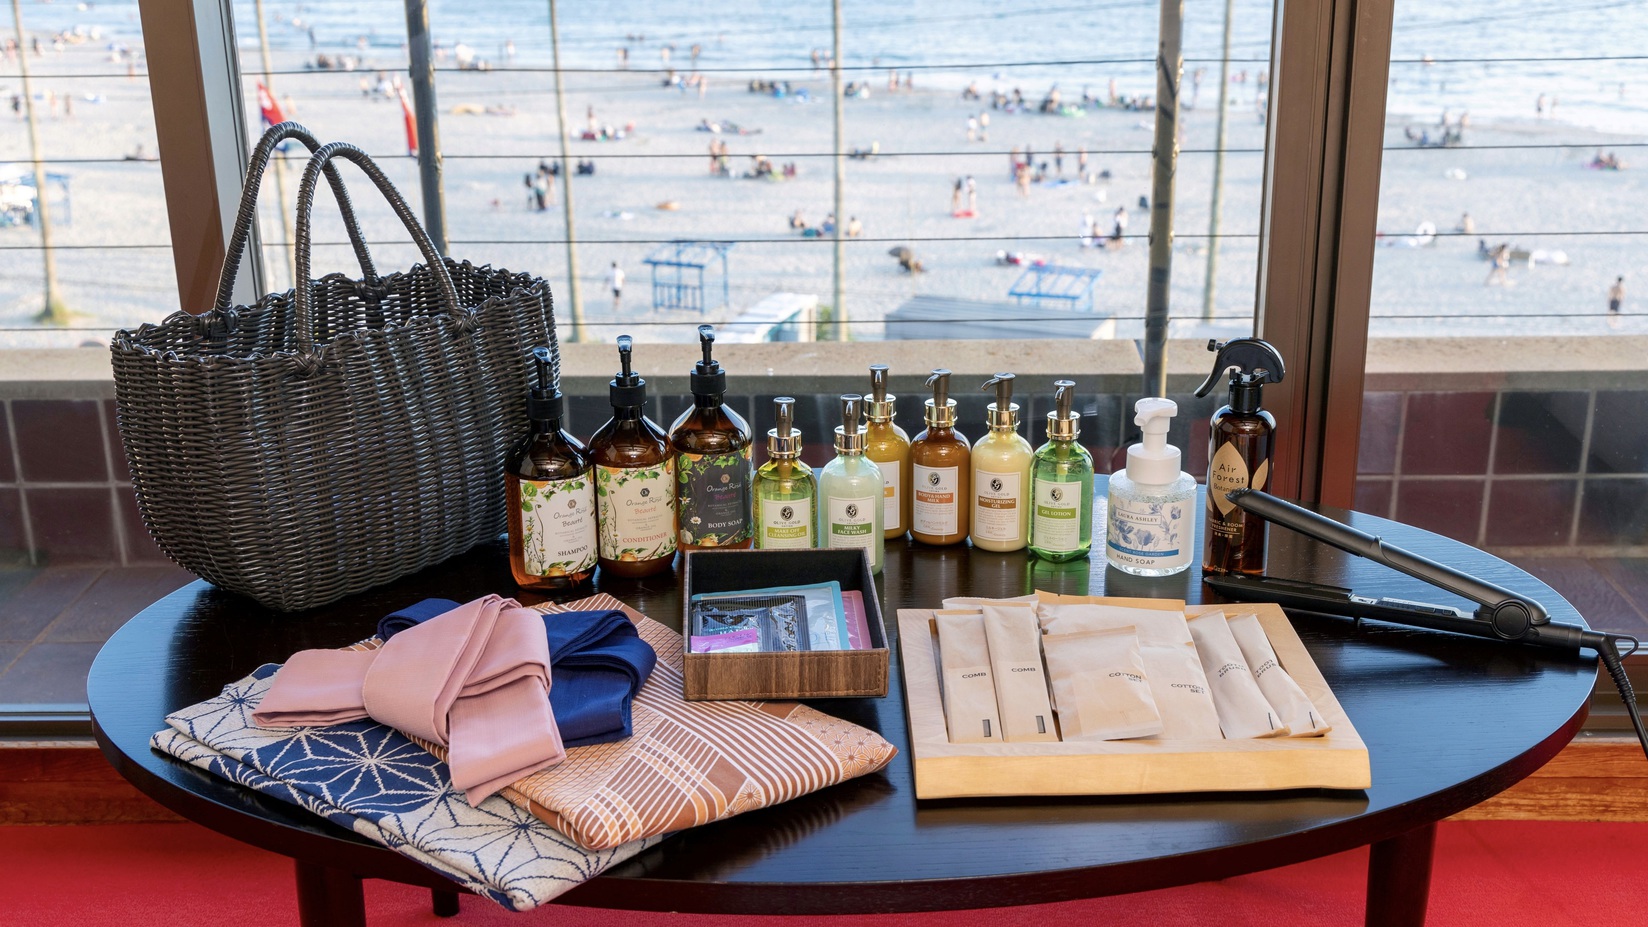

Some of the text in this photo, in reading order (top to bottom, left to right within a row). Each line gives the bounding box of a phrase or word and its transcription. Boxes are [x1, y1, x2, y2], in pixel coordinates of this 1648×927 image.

[1218, 463, 1237, 473] Air
[1212, 470, 1245, 484] Forest
[979, 496, 1015, 504] MOISTURIZING
[1117, 510, 1159, 523] LAURA ASHLEY
[707, 518, 743, 530] BODY SOAP
[622, 532, 668, 543] CONDITIONER
[557, 545, 588, 557] SHAMPOO
[1116, 553, 1133, 563] HAND
[1108, 671, 1142, 680] COTTON
[1257, 663, 1277, 678] BRUS
